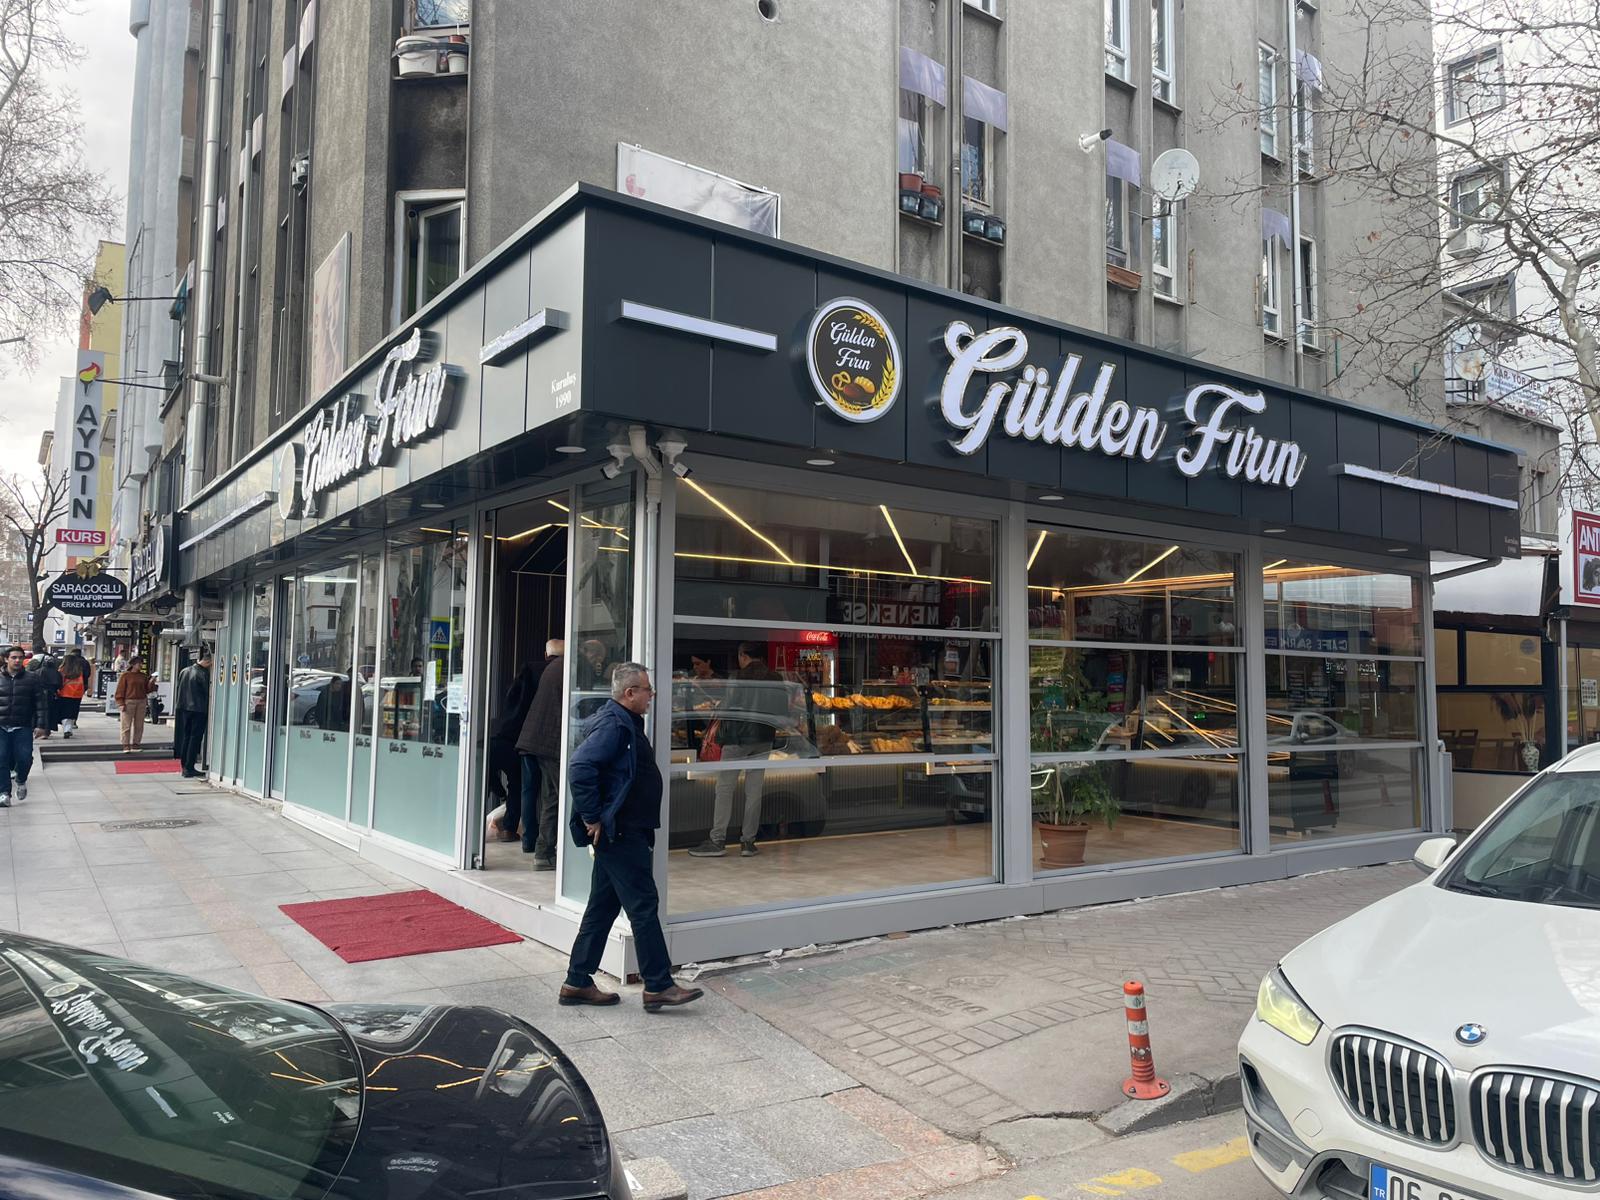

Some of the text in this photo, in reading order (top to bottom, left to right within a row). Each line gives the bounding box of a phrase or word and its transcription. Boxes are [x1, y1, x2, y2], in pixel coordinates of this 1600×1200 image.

[830, 322, 876, 348] Gülden
[836, 347, 872, 371] Fırın
[555, 390, 572, 409] 1990
[940, 320, 1307, 489] Gülden Fırın
[72, 404, 98, 519] AYDIN
[61, 530, 102, 543] KURS
[1374, 1186, 1386, 1199] TR
